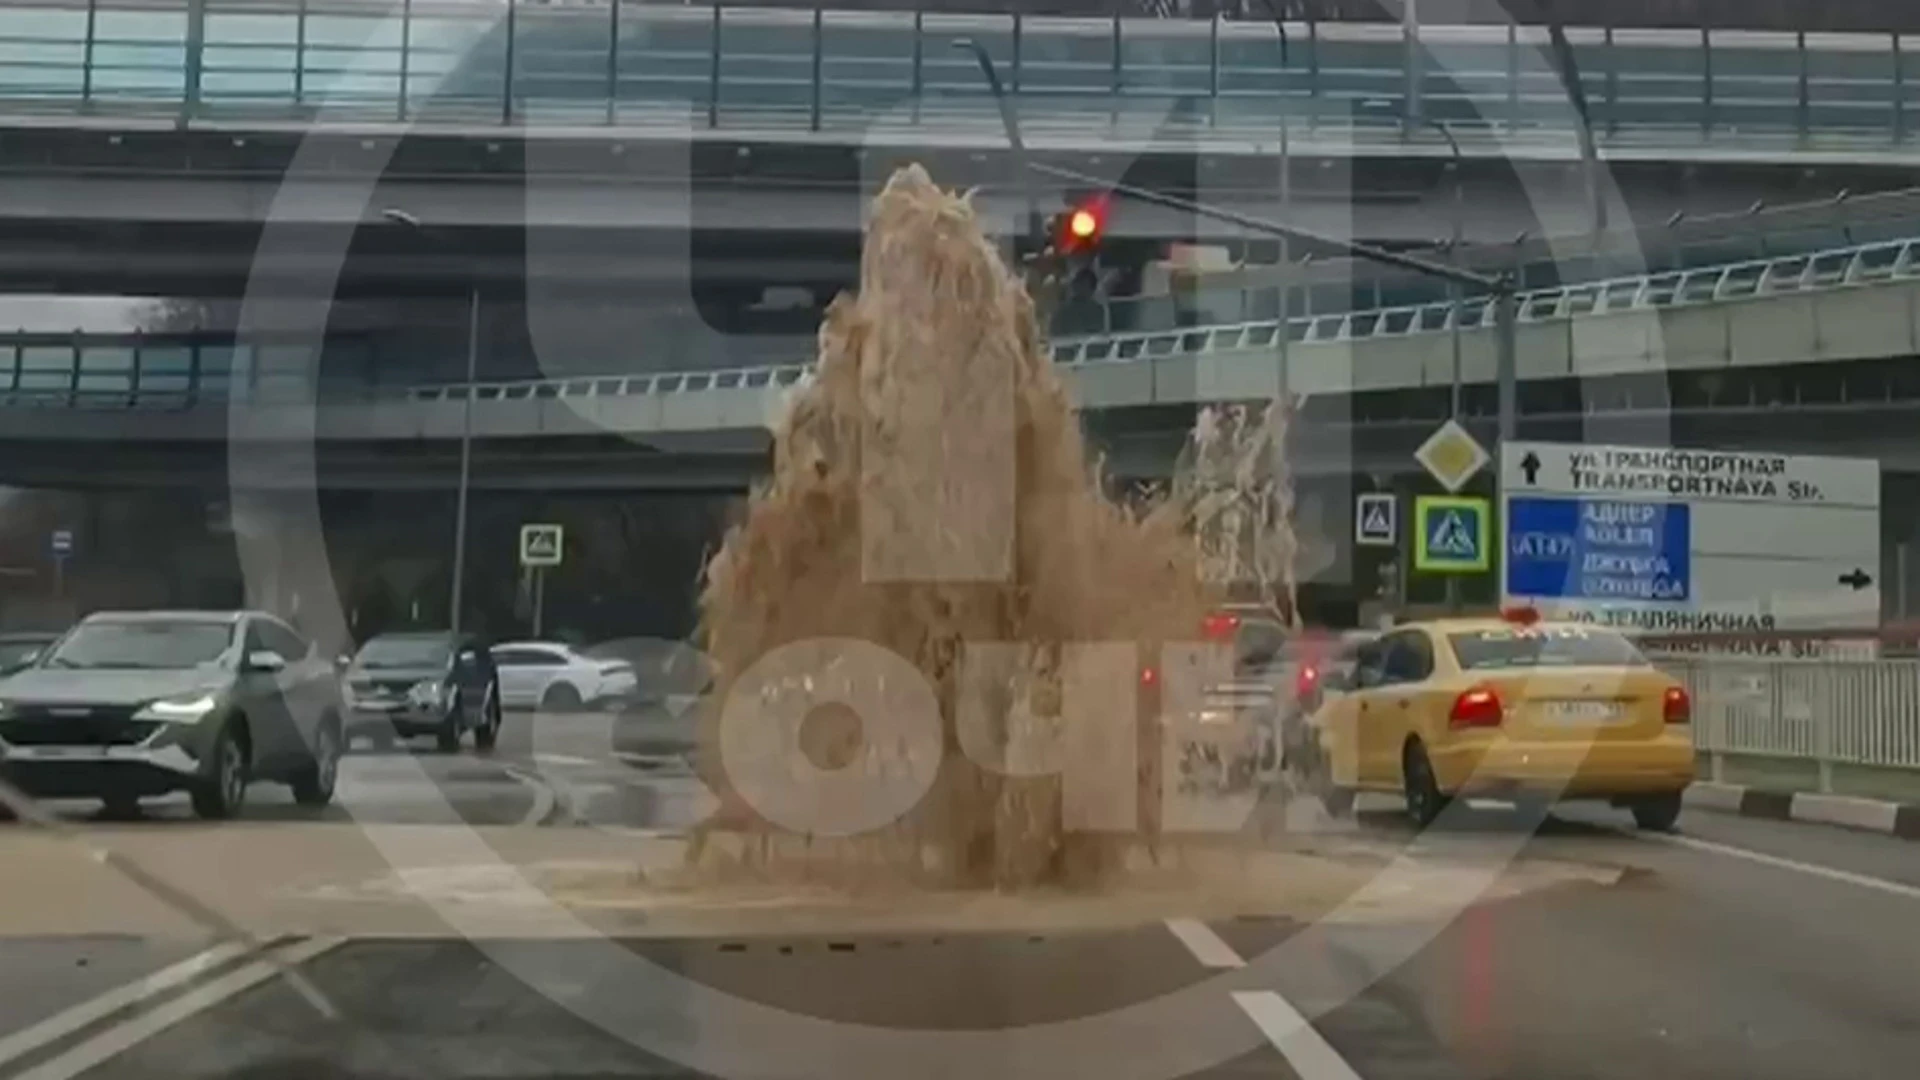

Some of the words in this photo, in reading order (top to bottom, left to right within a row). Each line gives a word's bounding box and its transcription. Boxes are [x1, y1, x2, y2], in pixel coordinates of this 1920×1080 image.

[1604, 452, 1786, 475] ТРАНСПОРТНАЯ
[1571, 469, 1777, 497] TRANSPORTNAYA
[1604, 610, 1776, 633] ЗЕМЛЯНИЧНАЯ
